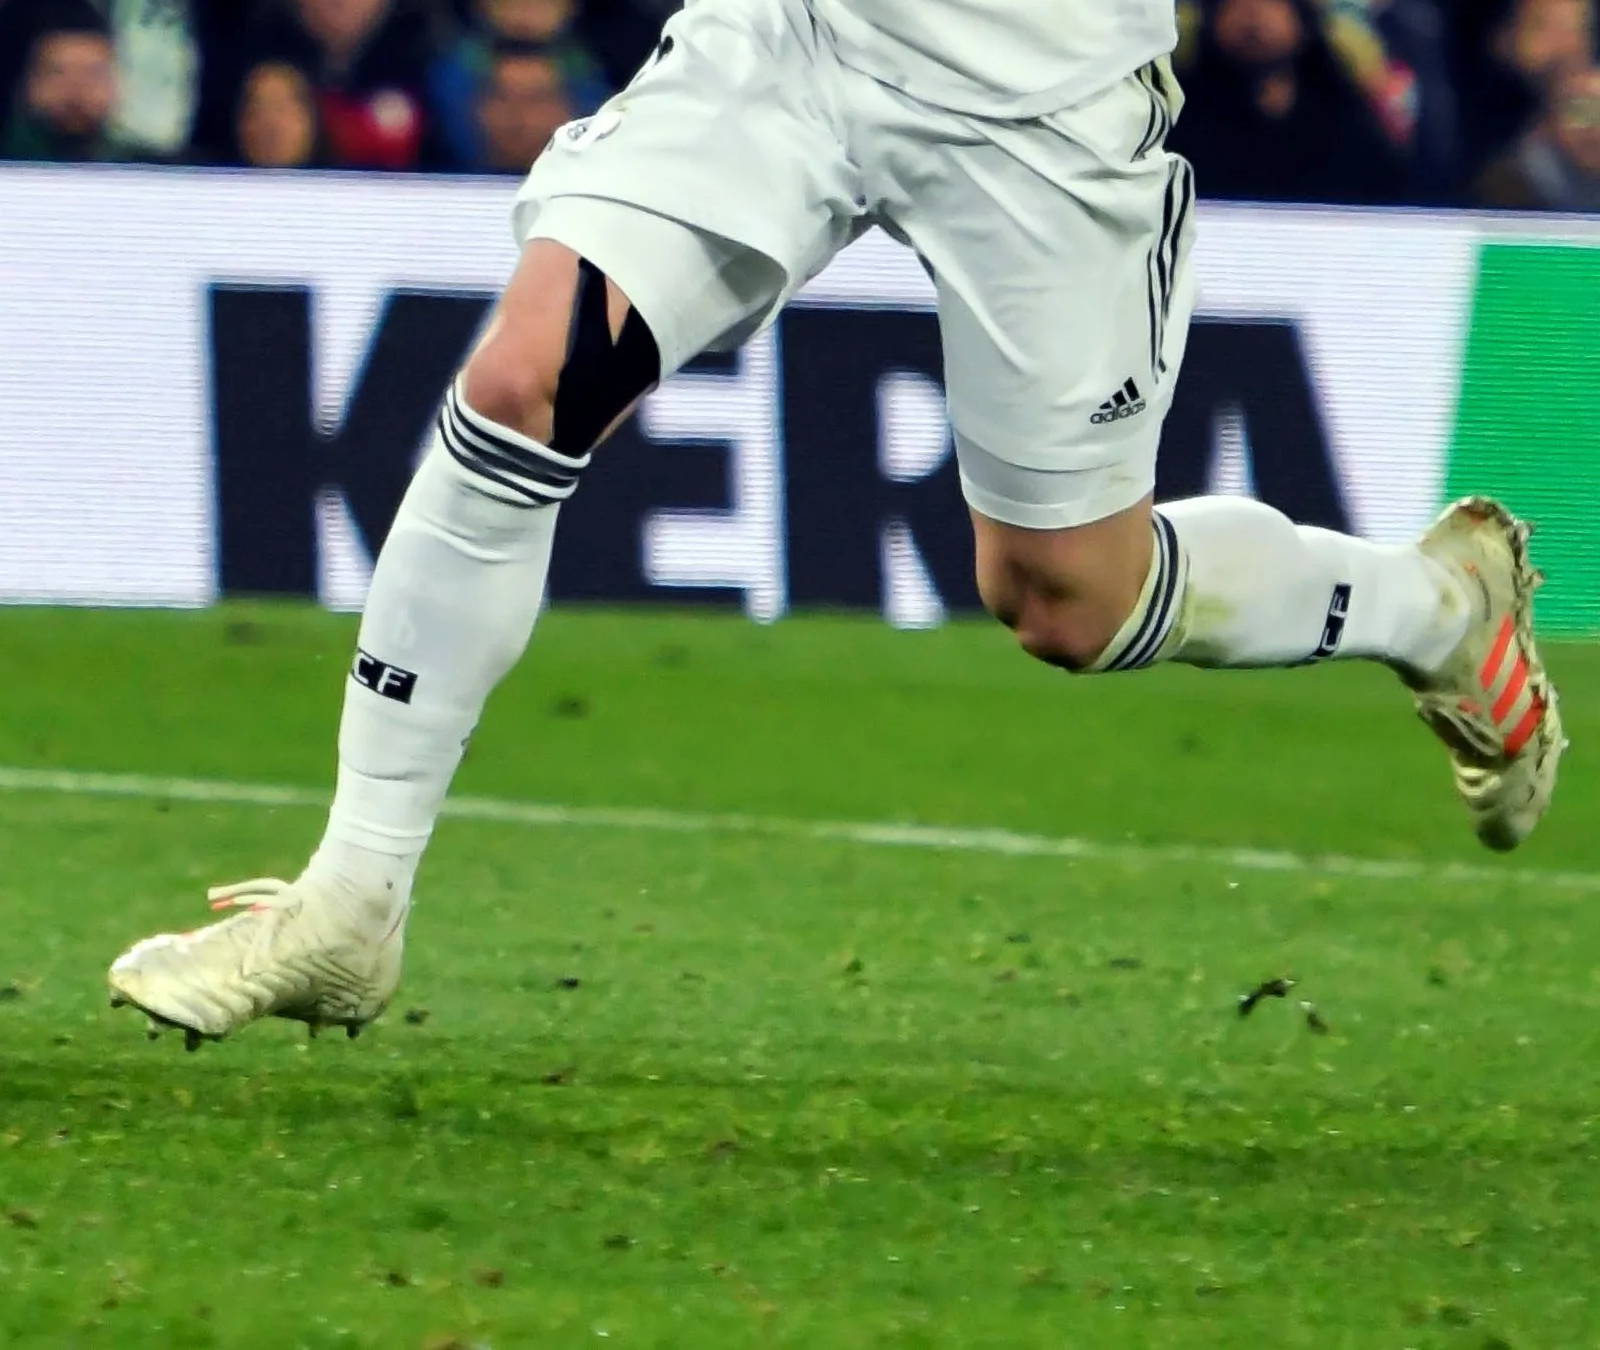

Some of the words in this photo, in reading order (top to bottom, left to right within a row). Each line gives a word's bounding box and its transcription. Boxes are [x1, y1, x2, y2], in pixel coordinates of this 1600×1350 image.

[1089, 398, 1147, 425] adidas
[205, 280, 1360, 615] KERA
[352, 652, 407, 693] CF
